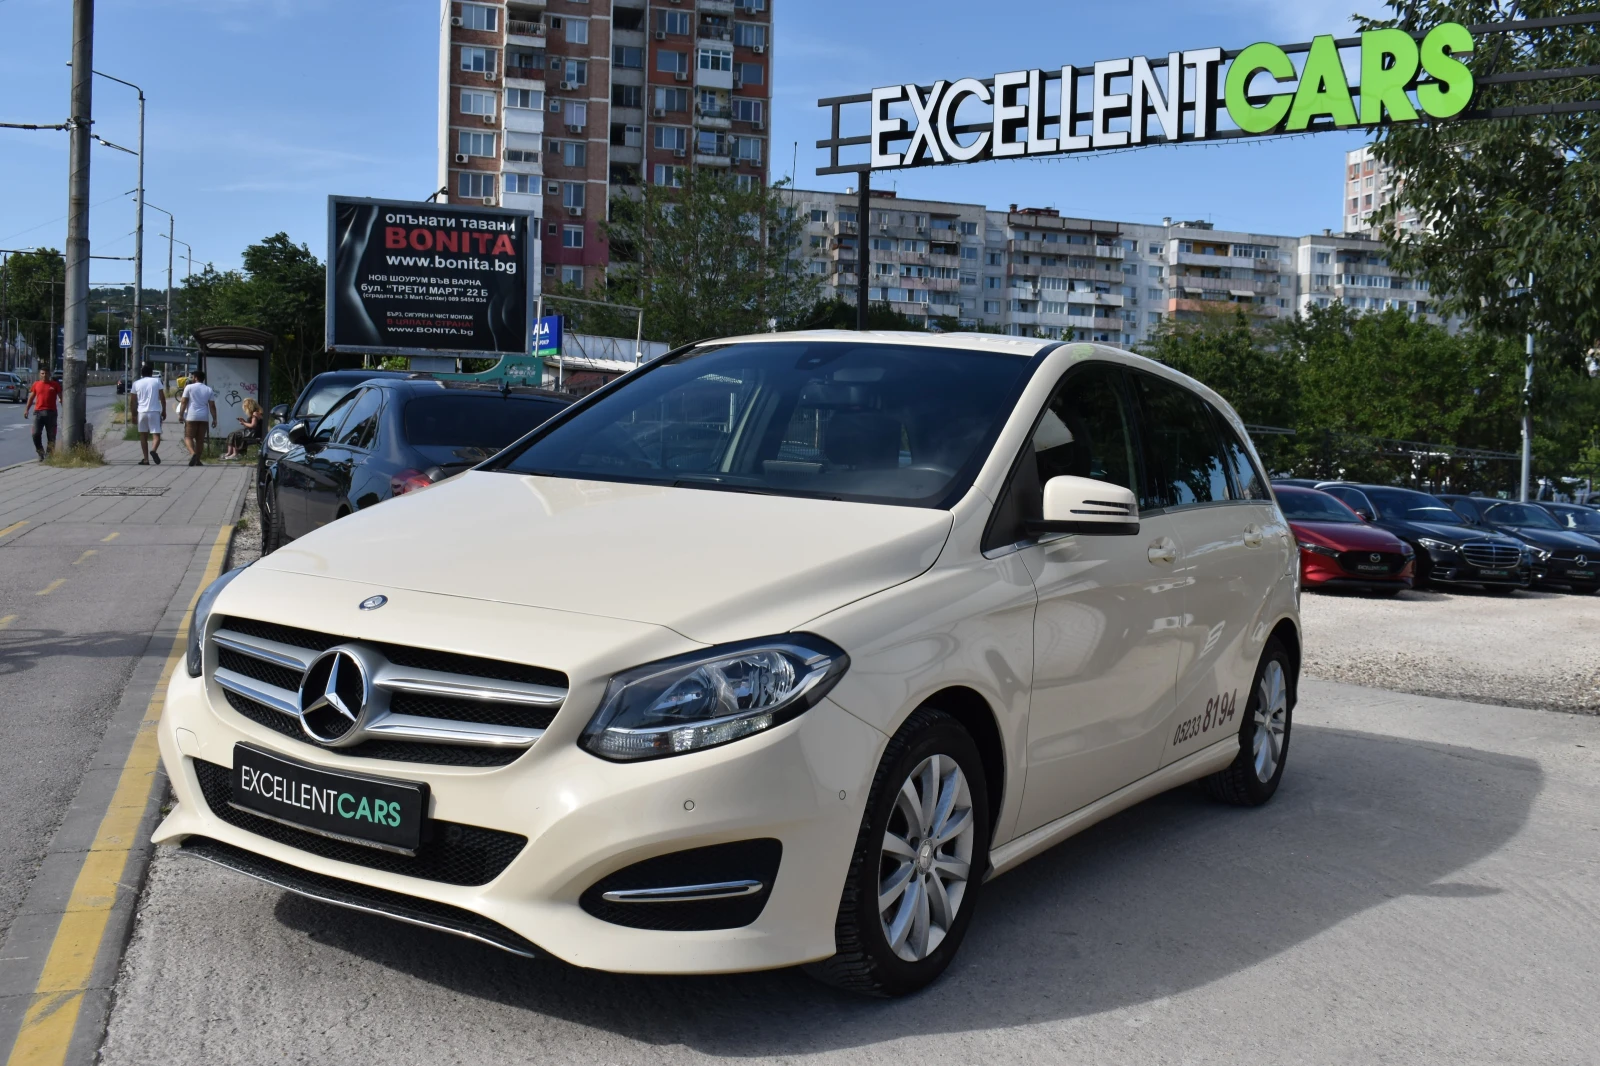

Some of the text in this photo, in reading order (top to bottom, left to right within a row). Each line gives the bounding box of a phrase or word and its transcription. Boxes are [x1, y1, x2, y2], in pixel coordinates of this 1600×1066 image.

[385, 213, 516, 232] опънати тавани
[385, 226, 516, 255] BONITA
[386, 255, 517, 274] www.bonita.bg
[361, 283, 384, 293] бул.
[466, 288, 479, 296] 22
[481, 289, 489, 297] Б
[389, 275, 428, 283] ШОУРУМ
[430, 277, 450, 285] ВЪВ
[451, 278, 482, 286] ВАРНА
[387, 327, 474, 336] www.BONITA.bg
[1173, 688, 1237, 746] 05233 8194
[241, 765, 401, 828] EXCELLENTCARS
